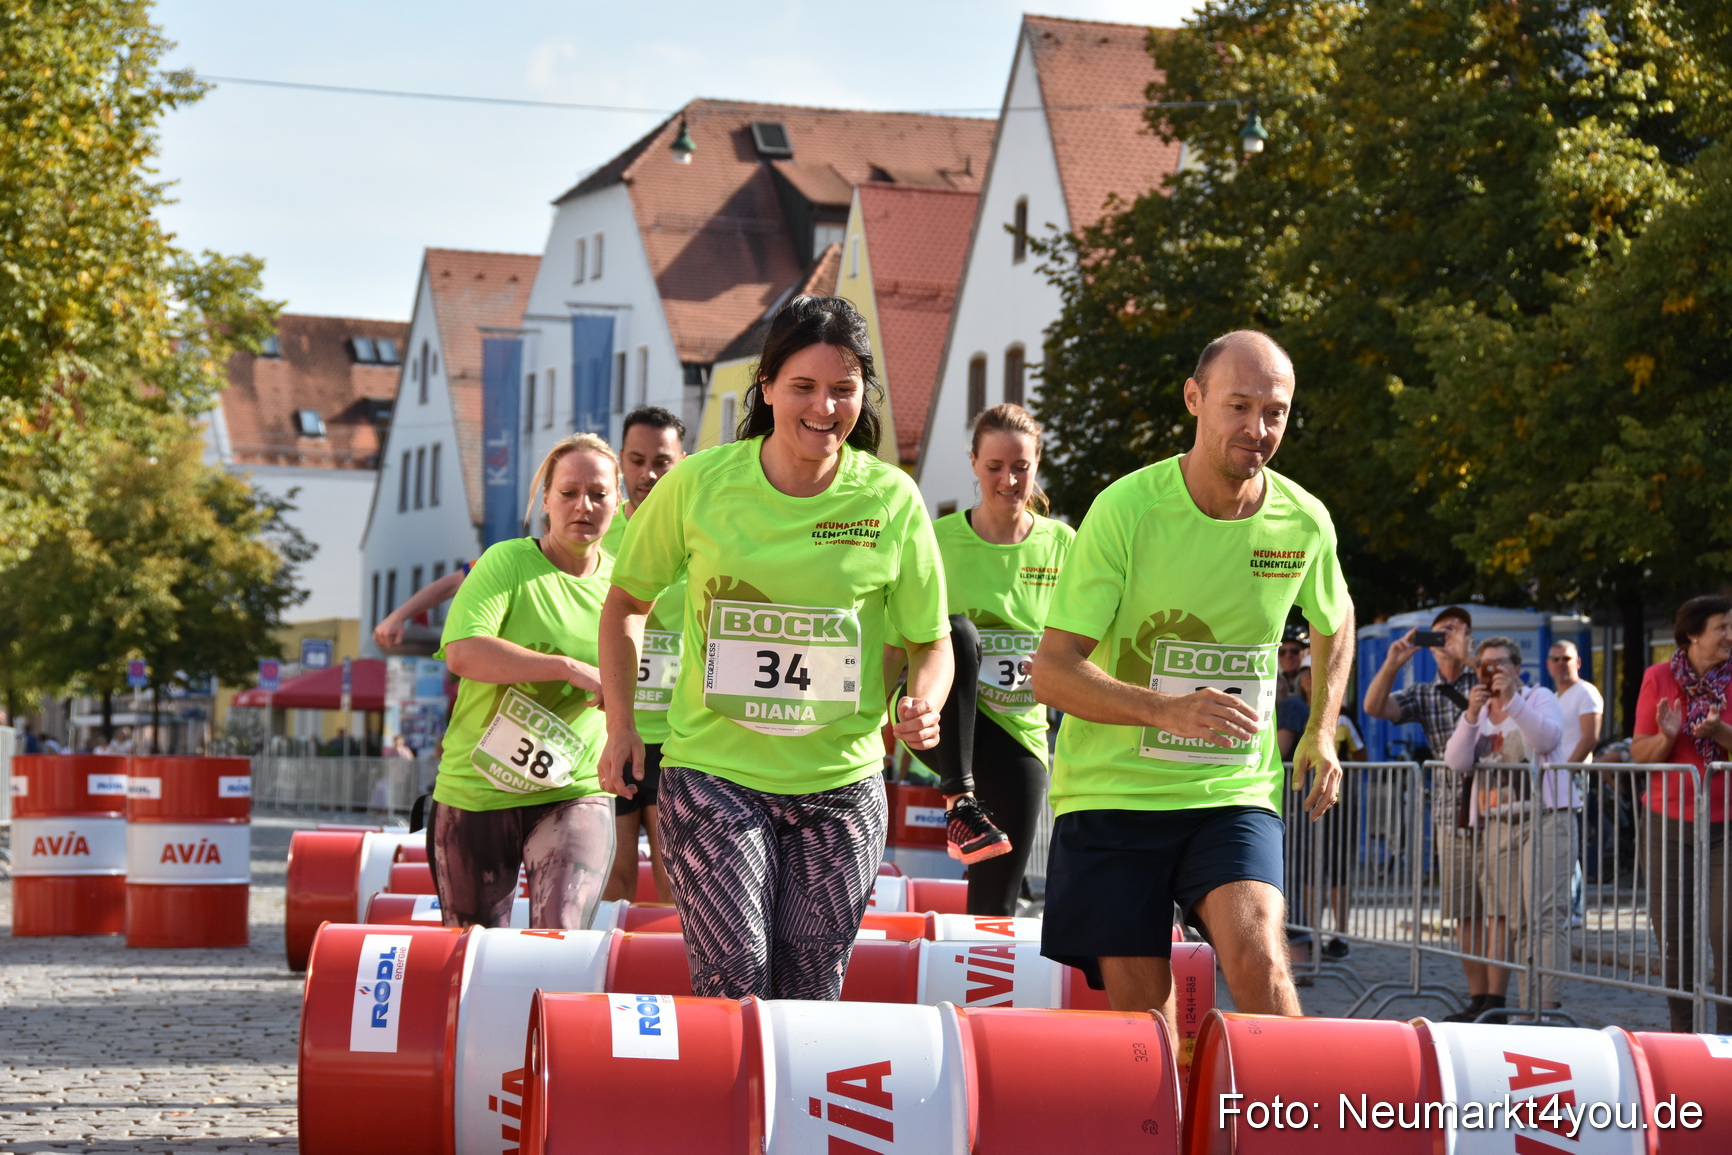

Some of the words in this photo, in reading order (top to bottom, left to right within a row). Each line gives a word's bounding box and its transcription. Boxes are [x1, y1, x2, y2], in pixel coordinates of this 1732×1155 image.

[811, 528, 881, 539] ELEMENTELAUF
[815, 518, 880, 530] NEUMARKTER
[862, 540, 877, 549] 2019
[1253, 549, 1306, 559] NEUMARKTER
[1250, 559, 1306, 569] ELEMENTELAUF
[1261, 571, 1291, 579] September
[720, 606, 849, 643] BOCK
[637, 658, 650, 682] 5
[753, 650, 811, 691] 34
[1163, 645, 1271, 676] BOCK
[634, 689, 664, 701] SEF
[978, 684, 1037, 703] KATHARIN
[744, 701, 817, 721] DIANA
[506, 695, 585, 762] BOCK
[510, 737, 554, 779] 38
[488, 762, 552, 792] MONIK
[394, 946, 407, 981] energie
[954, 943, 1017, 1008] VIA
[1132, 1042, 1149, 1063] 323
